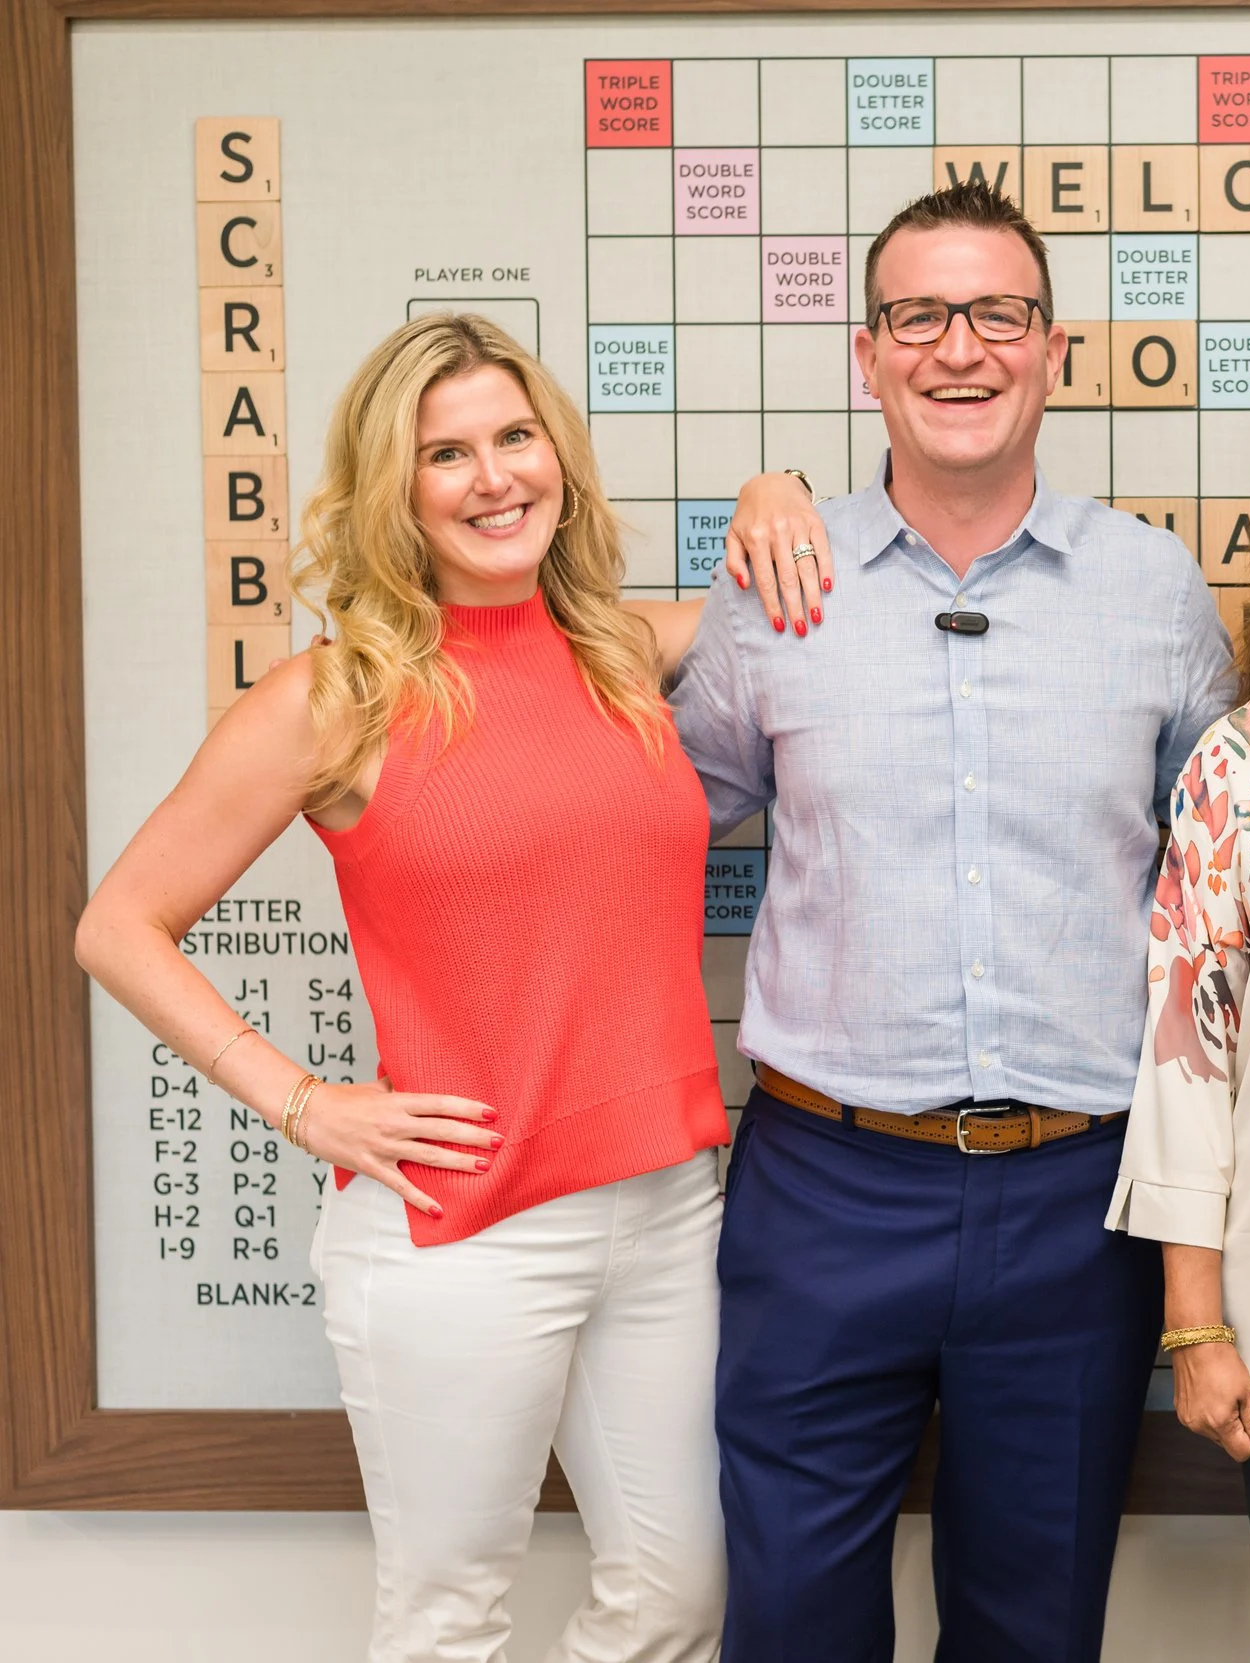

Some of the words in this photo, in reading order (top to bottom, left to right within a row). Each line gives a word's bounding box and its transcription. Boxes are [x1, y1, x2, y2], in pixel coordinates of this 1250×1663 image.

[597, 75, 660, 90] TRIPLE
[853, 73, 928, 89] DOUBLE
[599, 96, 658, 111] WORD
[856, 95, 925, 109] LETTER
[598, 117, 660, 132] SCORE
[860, 115, 921, 130] SCORE
[679, 163, 754, 178] DOUBLE
[687, 184, 746, 199] WORD
[686, 205, 747, 220] SCORE
[767, 251, 842, 266] DOUBLE
[1117, 249, 1192, 264] DOUBLE
[414, 267, 484, 282] PLAYER
[491, 267, 530, 282] ONE
[775, 272, 834, 287] WORD
[1120, 270, 1188, 285] LETTER
[774, 293, 835, 308] SCORE
[1123, 291, 1185, 306] SCORE
[594, 340, 668, 355] DOUBLE
[598, 361, 665, 376] LETTER
[601, 382, 662, 396] SCORE
[219, 131, 268, 689] SCRABBL
[688, 515, 732, 530] TRIP
[686, 536, 726, 551] LETT
[705, 864, 755, 879] RIPLE
[704, 884, 757, 899] ETTER
[705, 904, 754, 920] CORE
[183, 932, 349, 955] STRIBUTION
[235, 978, 268, 1002] J-1
[308, 978, 353, 1002] S-4
[309, 1010, 352, 1035] T-6
[308, 1043, 356, 1067] U-4
[151, 1076, 199, 1099] D-4
[149, 1108, 202, 1131] E-12
[155, 1140, 197, 1163] F-2
[230, 1140, 279, 1164] O-8
[153, 1172, 199, 1196] G-3
[233, 1172, 277, 1196] P-2
[154, 1204, 200, 1228] H-2
[234, 1204, 275, 1228] Q-1
[160, 1237, 195, 1260] I-9
[233, 1237, 279, 1261] R-6
[197, 1283, 316, 1306] BLANK-2
